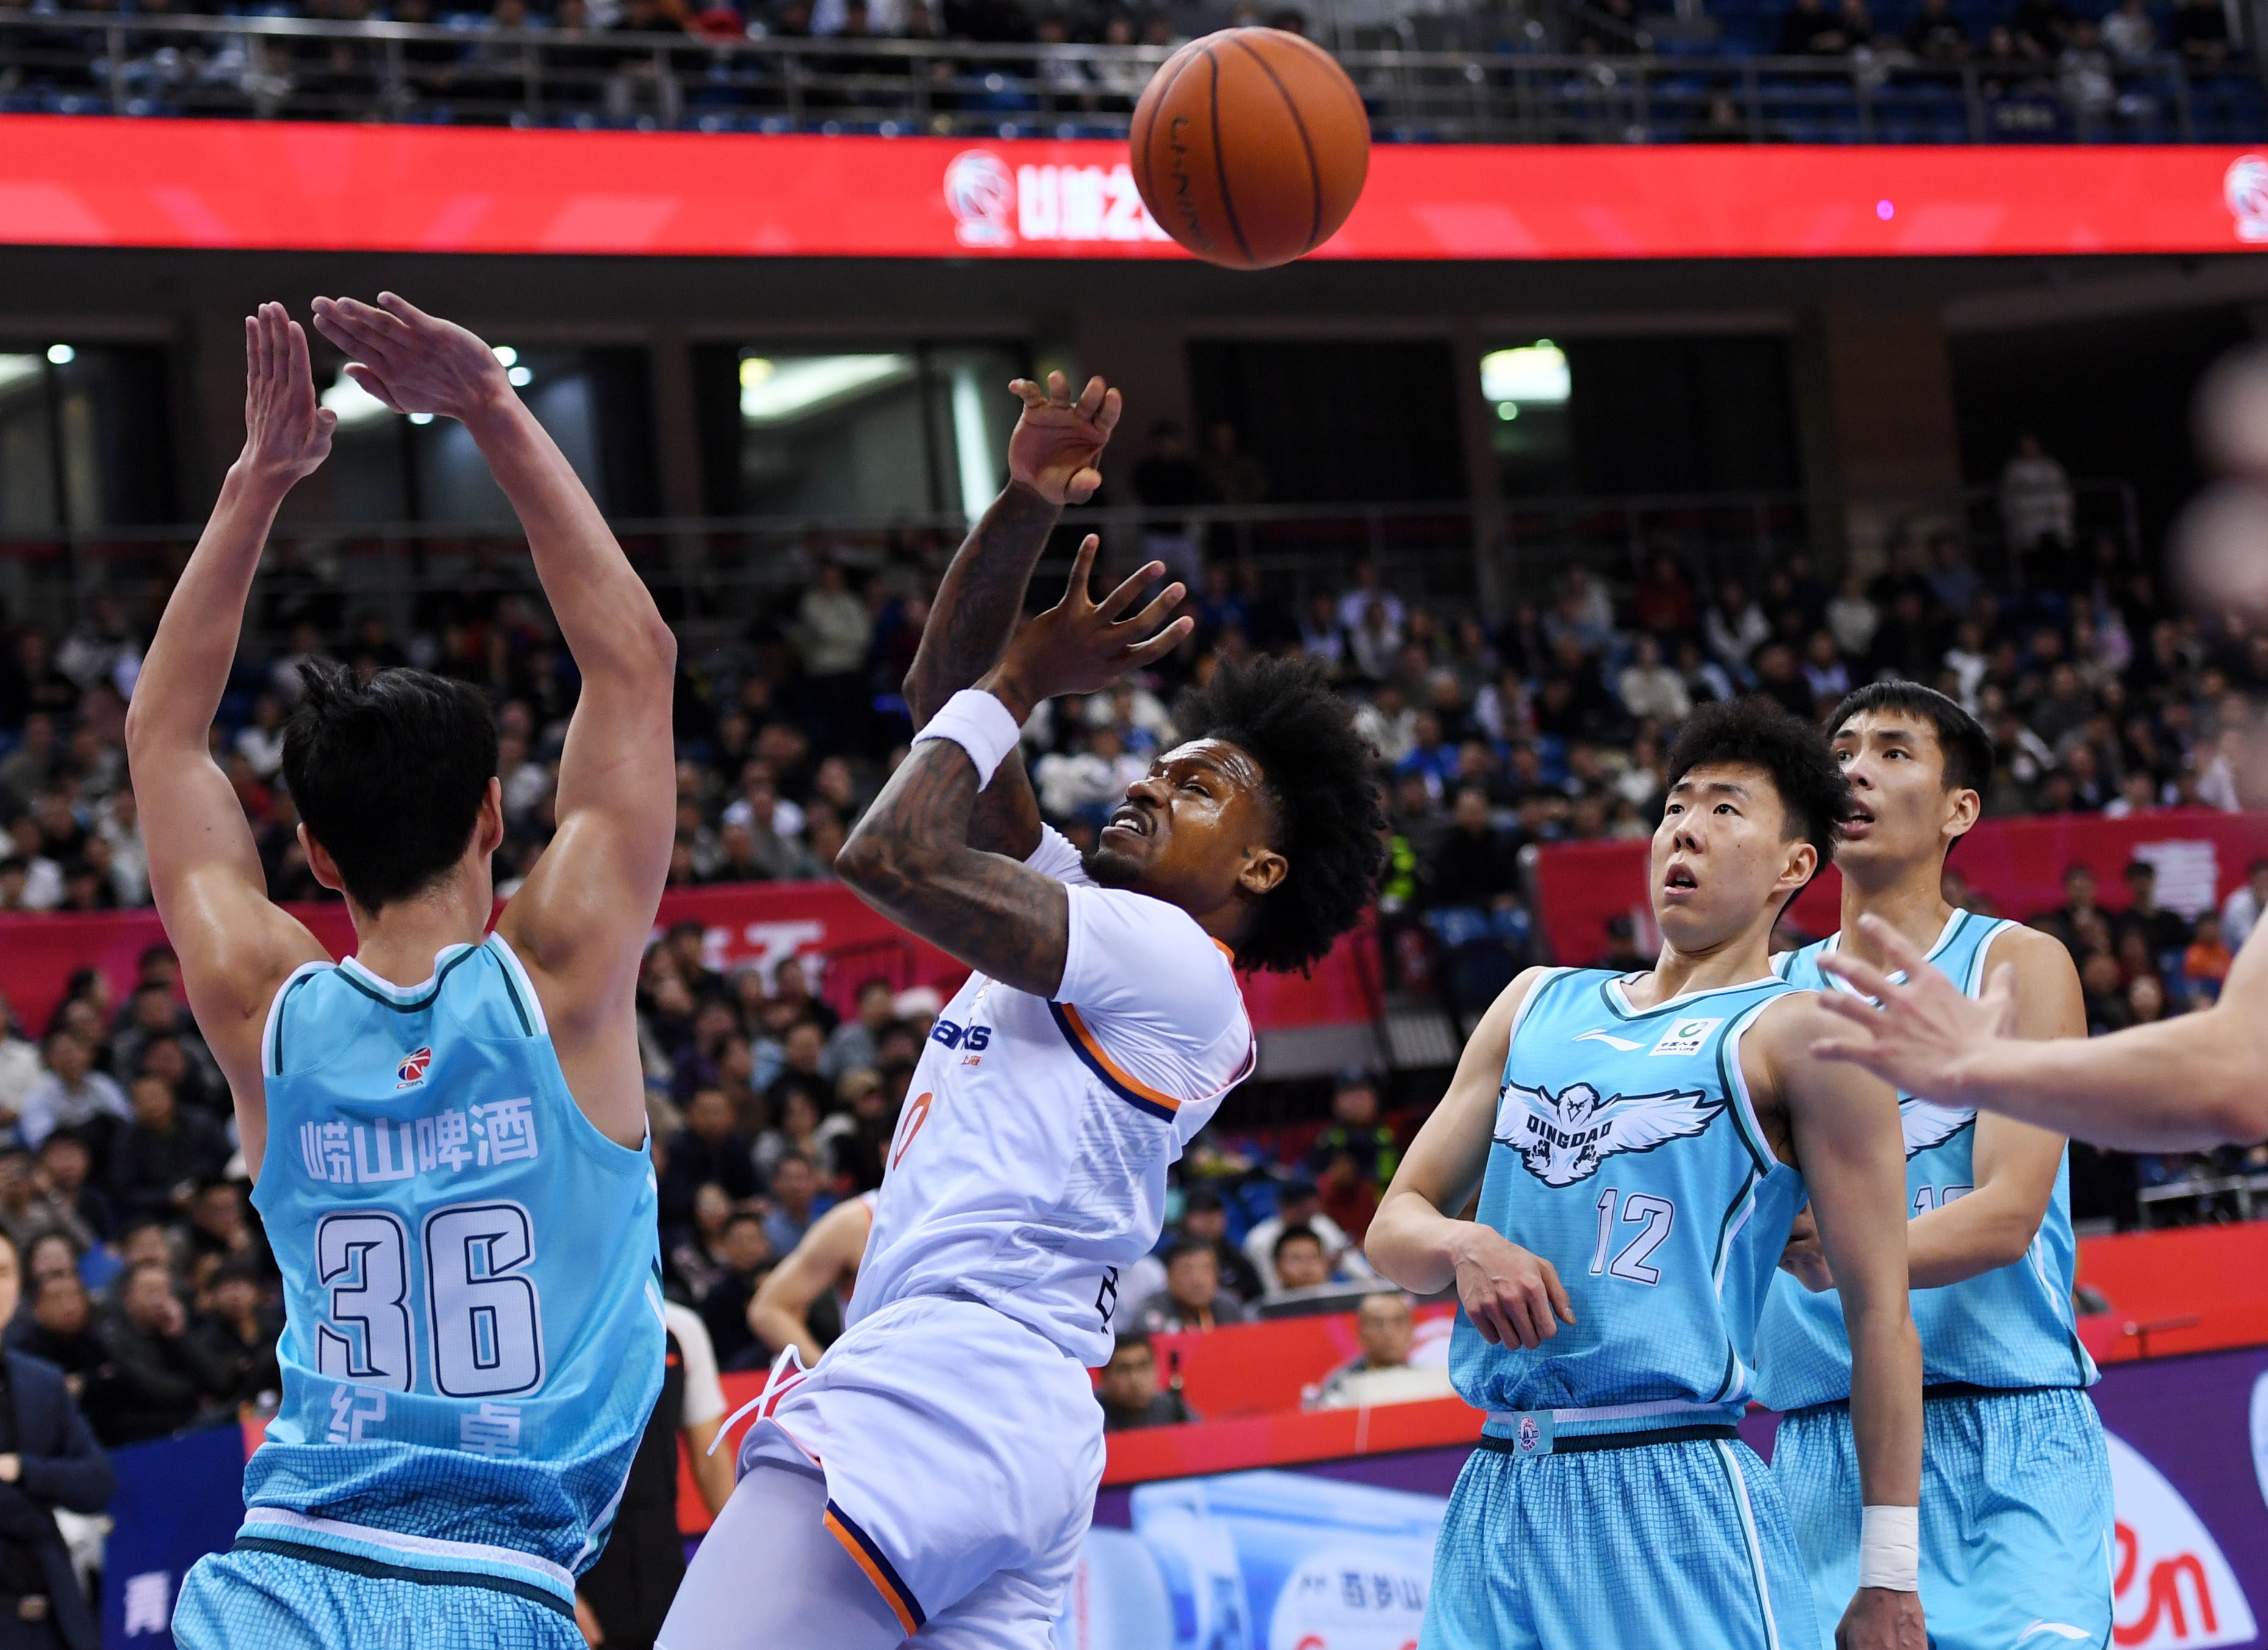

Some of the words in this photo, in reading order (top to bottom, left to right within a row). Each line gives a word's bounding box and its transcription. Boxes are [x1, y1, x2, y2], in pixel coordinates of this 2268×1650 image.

[300, 1097, 538, 1184] 崂山啤酒
[1526, 1114, 1613, 1150] QINGDAO
[1589, 1187, 1675, 1287] 12
[314, 1200, 546, 1399] 36
